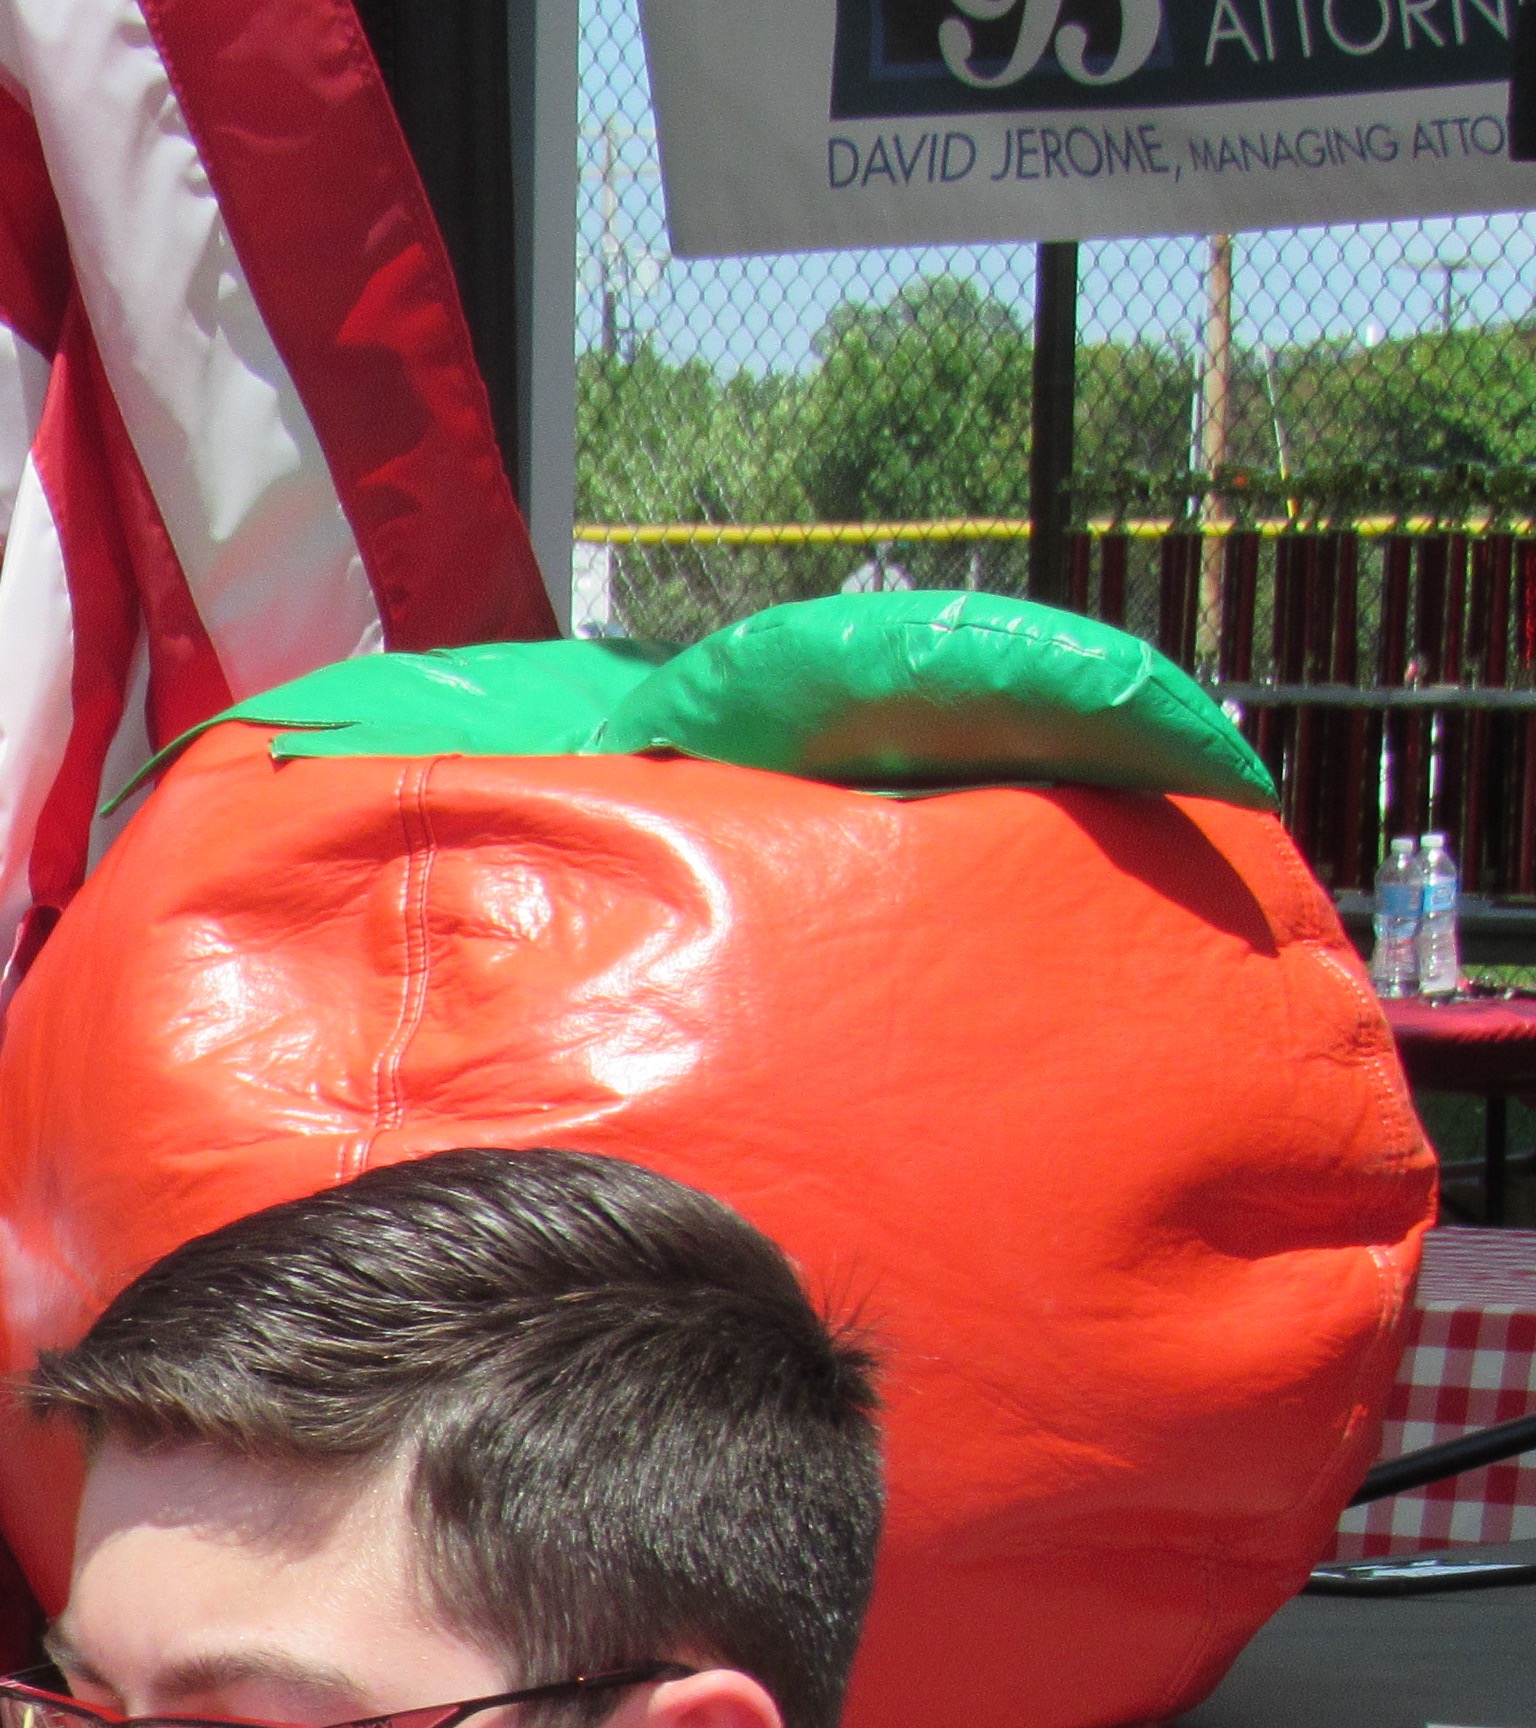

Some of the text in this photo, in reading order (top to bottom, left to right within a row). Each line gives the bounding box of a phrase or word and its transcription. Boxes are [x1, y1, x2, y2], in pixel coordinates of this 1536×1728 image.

[828, 114, 1506, 189] DAVID JEROME, MANAGING ATTO
